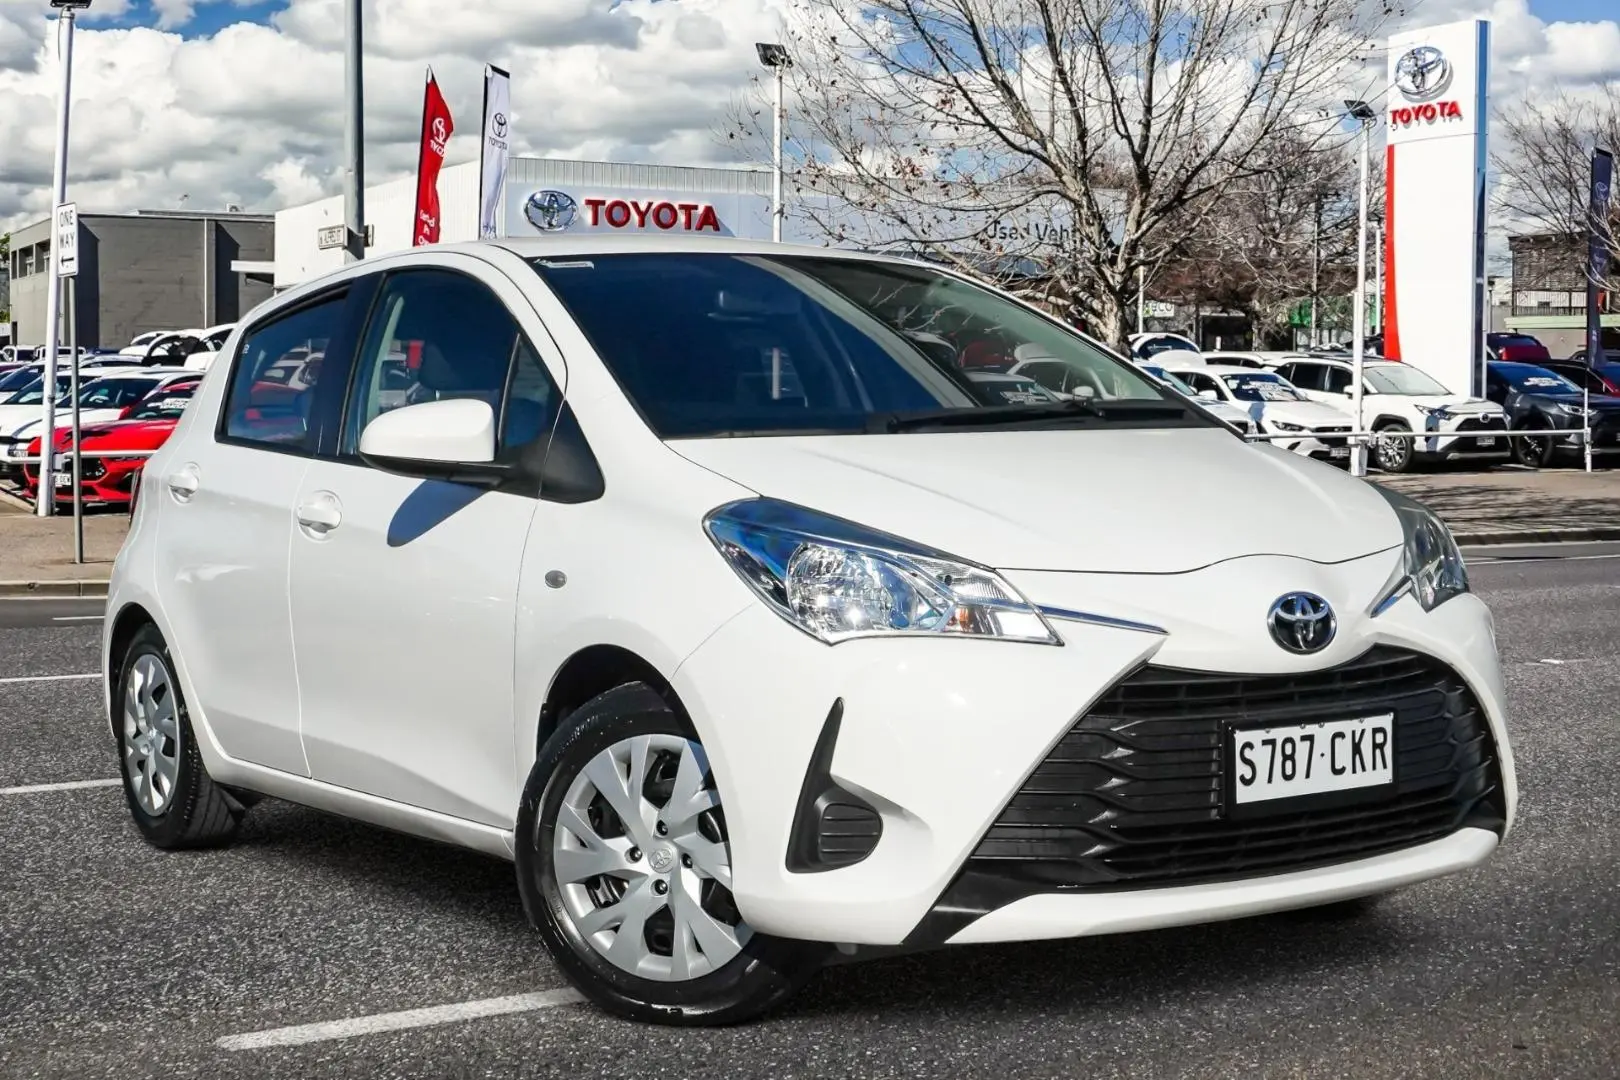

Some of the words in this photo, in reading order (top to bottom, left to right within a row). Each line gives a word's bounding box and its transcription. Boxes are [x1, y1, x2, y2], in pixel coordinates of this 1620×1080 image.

[1389, 101, 1463, 125] TOYOTA
[59, 209, 74, 227] ONE
[584, 198, 720, 232] TOYOTA
[59, 232, 75, 249] WAY
